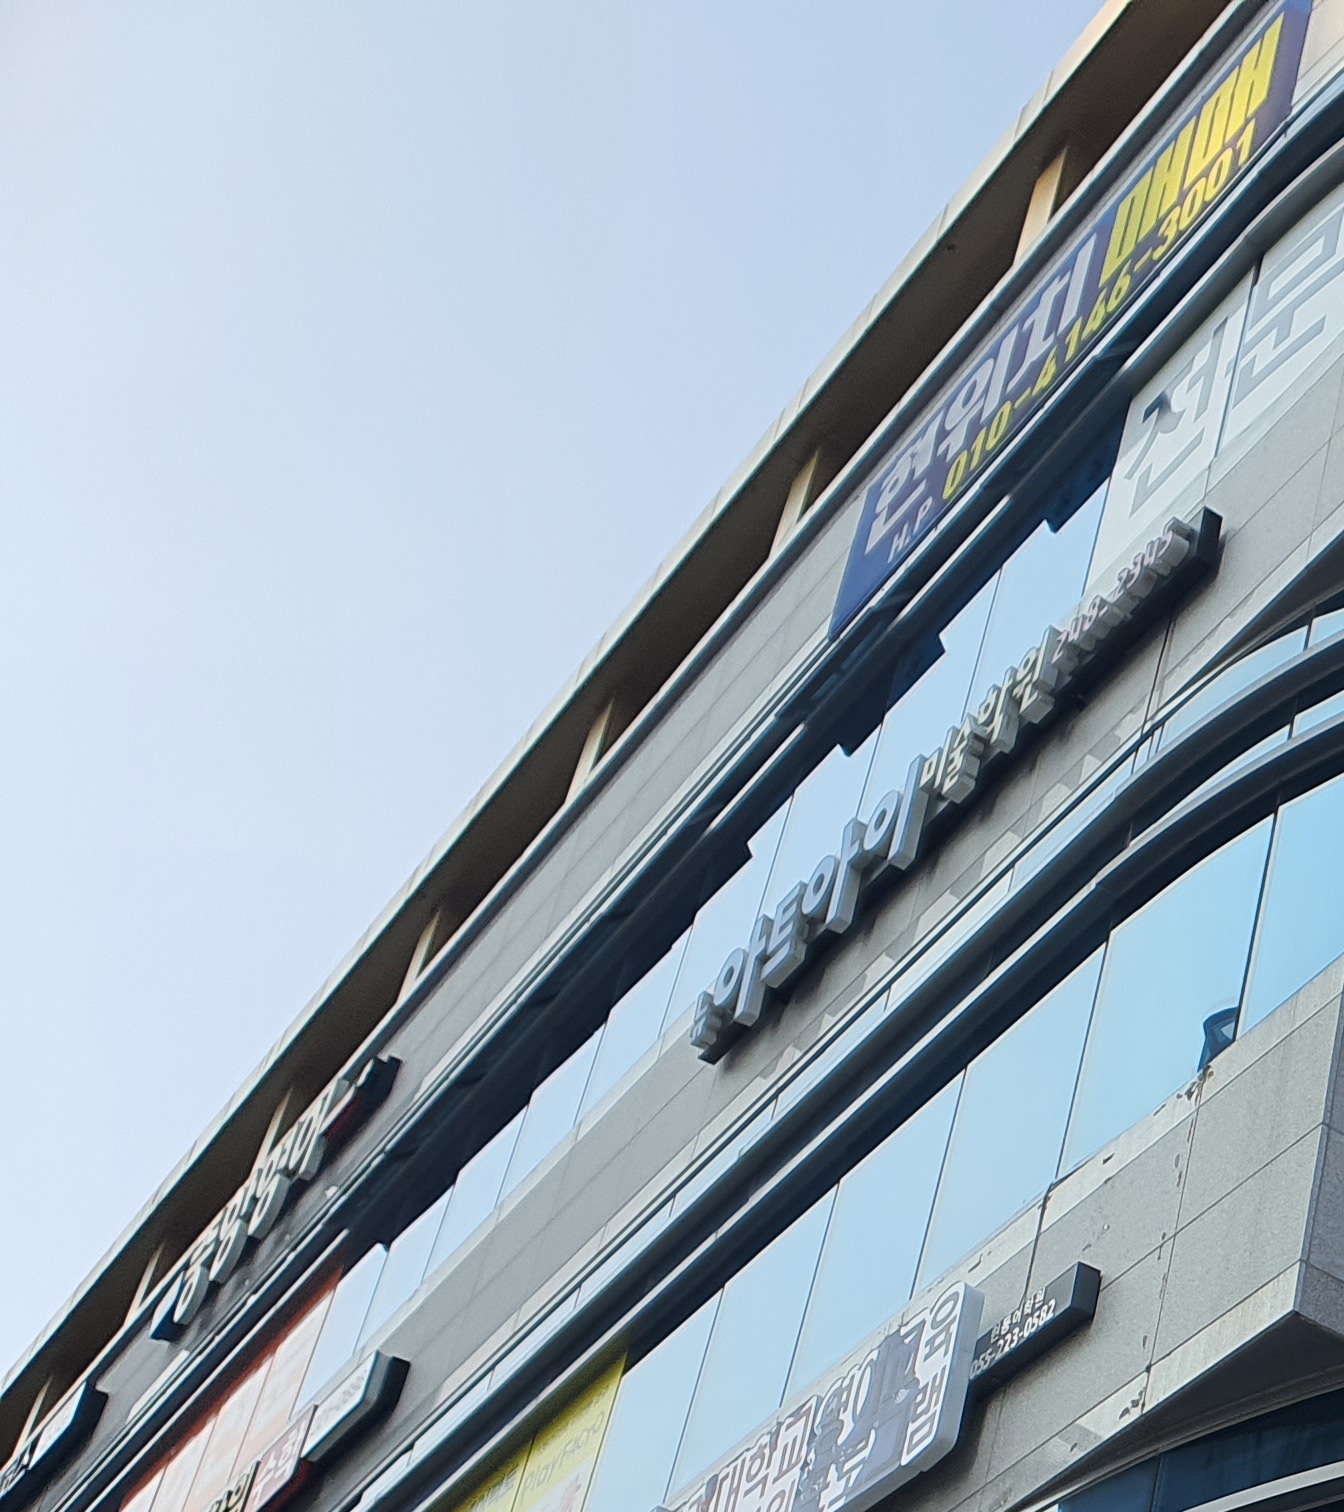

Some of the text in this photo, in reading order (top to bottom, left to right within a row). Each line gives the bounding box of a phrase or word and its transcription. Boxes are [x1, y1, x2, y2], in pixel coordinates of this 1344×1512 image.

[865, 11, 1285, 555] 현위치 매매
[943, 118, 1257, 499] 010-4146-3001
